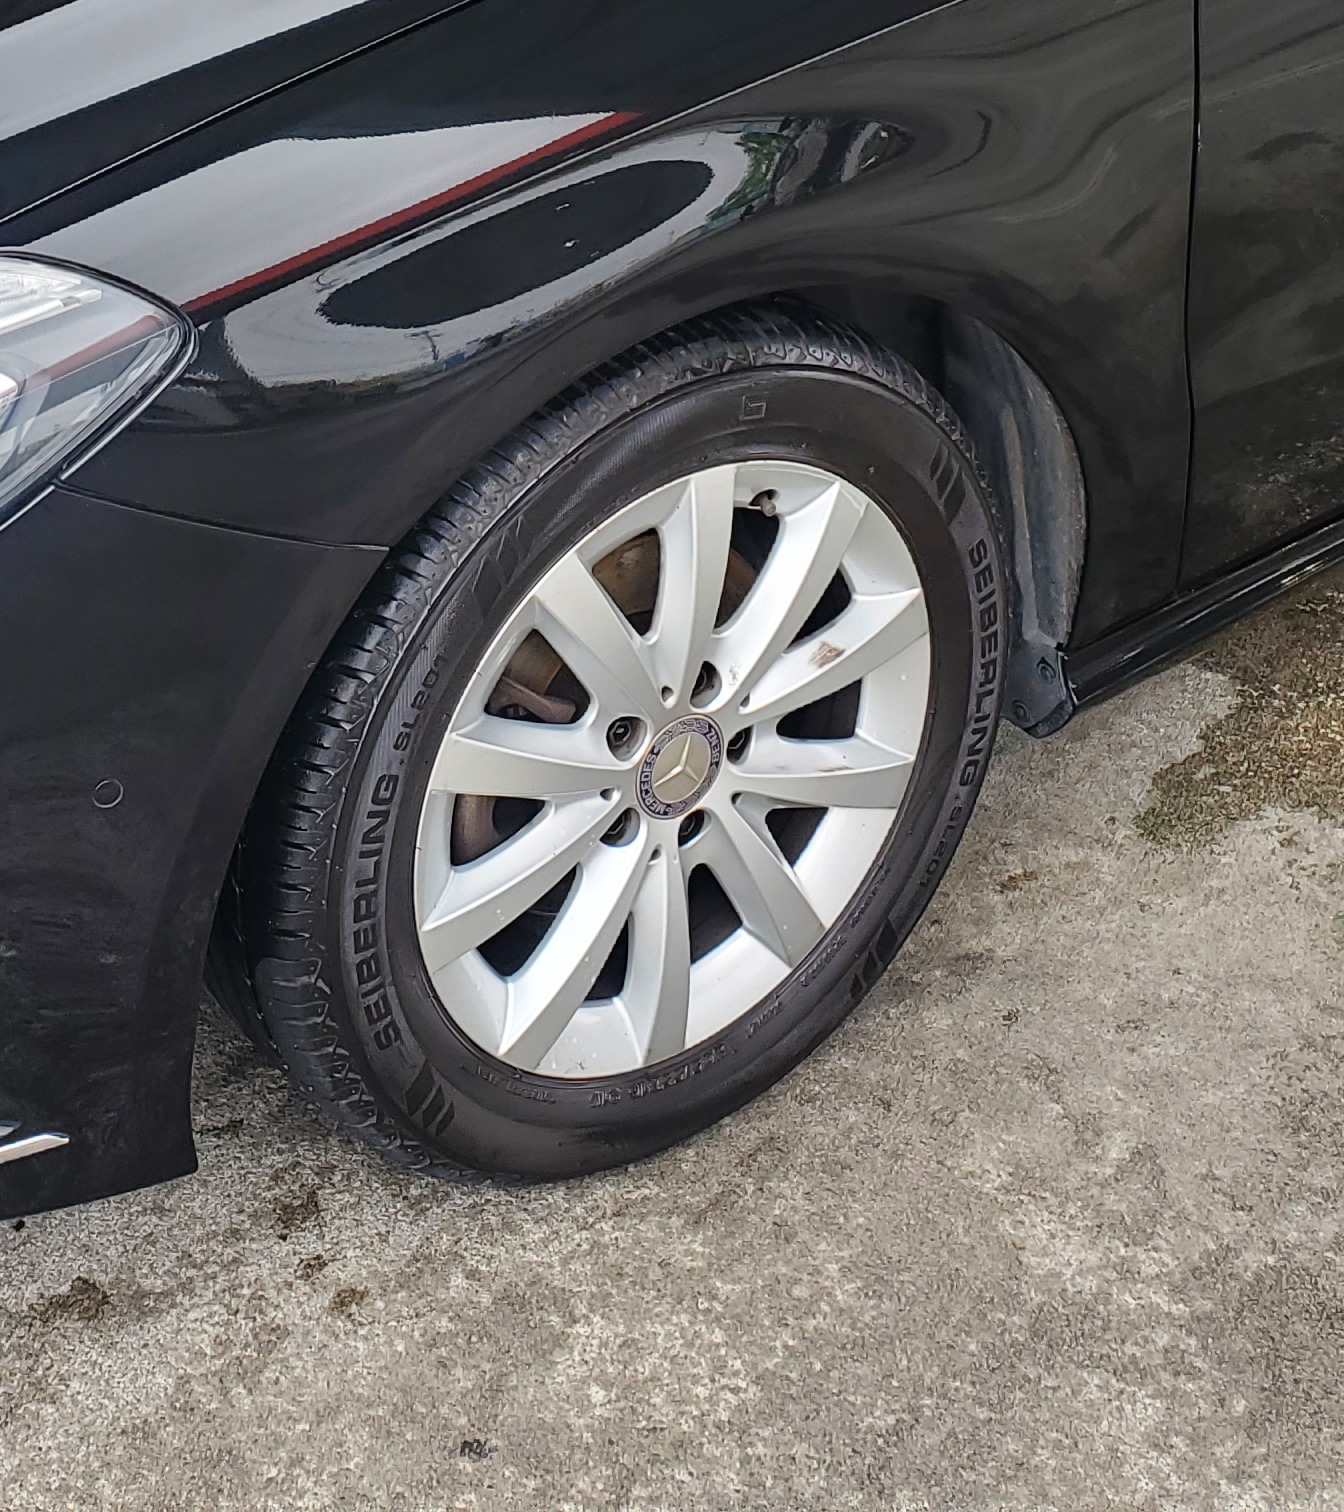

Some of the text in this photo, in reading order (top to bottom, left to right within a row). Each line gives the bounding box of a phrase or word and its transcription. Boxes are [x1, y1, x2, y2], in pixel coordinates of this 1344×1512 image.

[958, 537, 999, 788] SEIBERLING
[640, 754, 668, 815] MERCEDES
[706, 728, 720, 764] BENZ
[353, 773, 401, 1051] SEIBERLING
